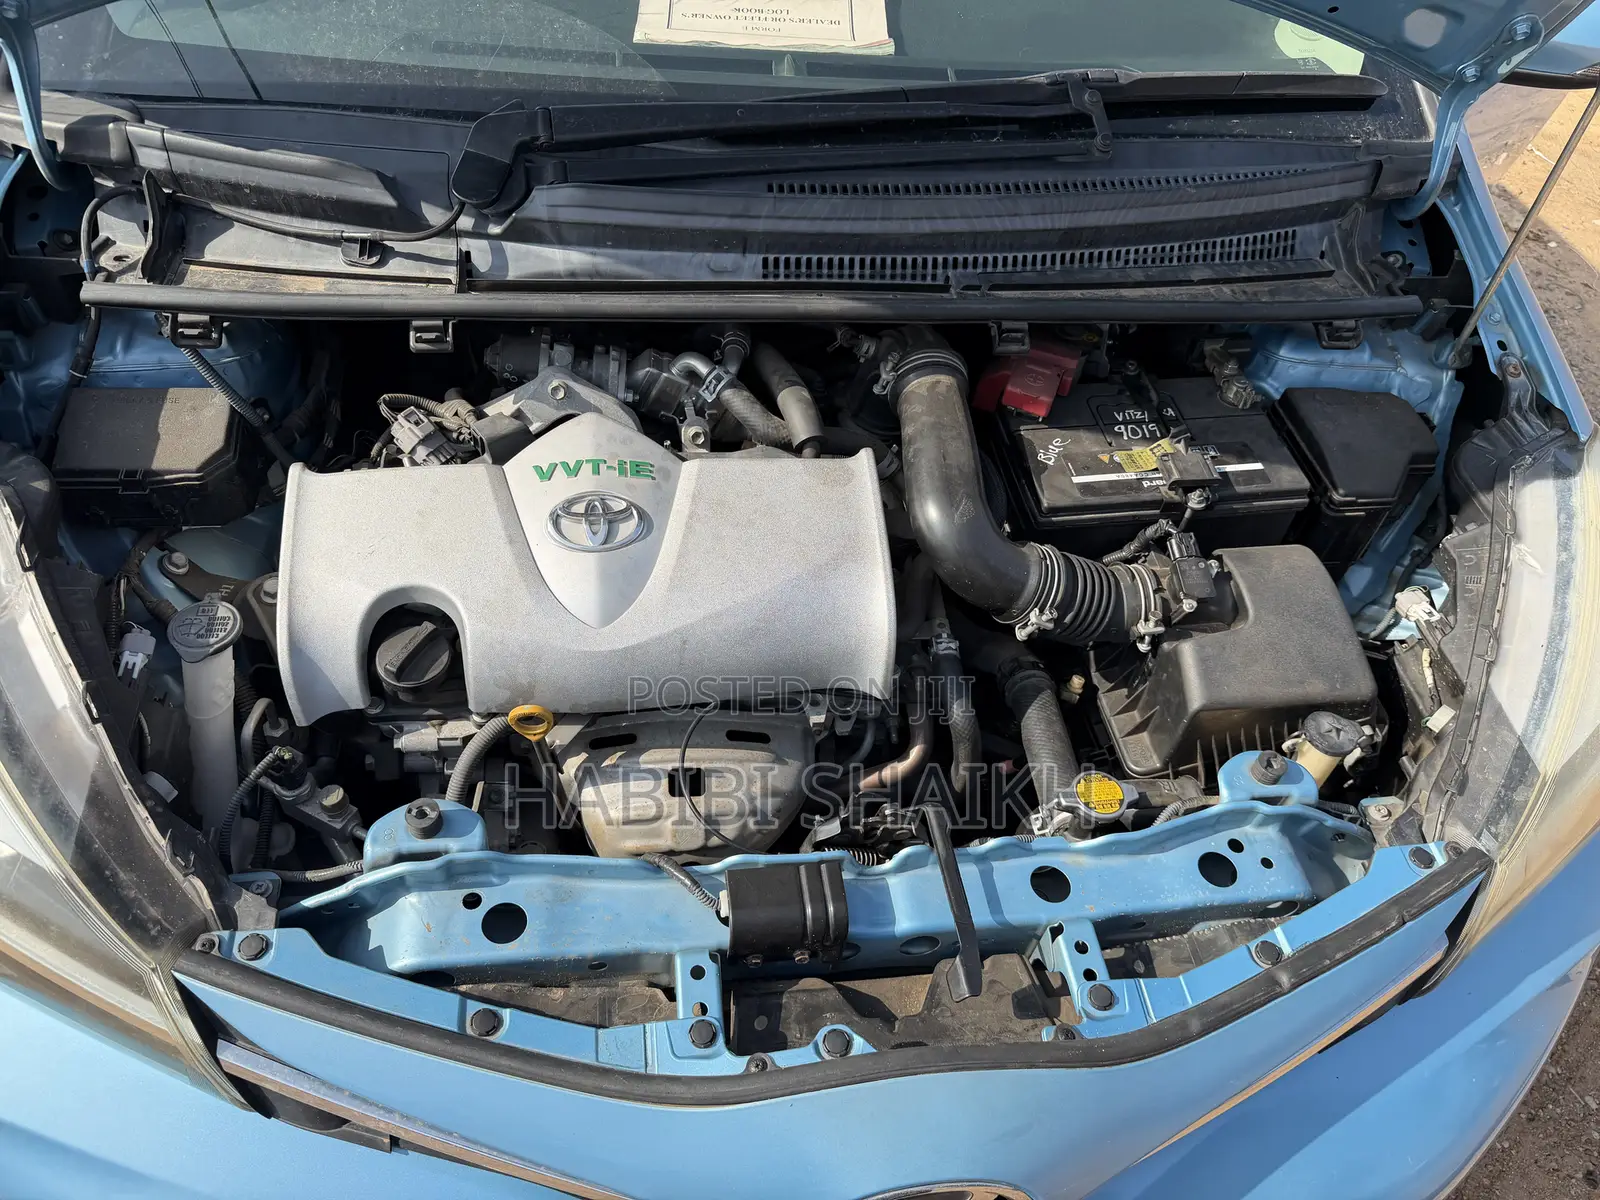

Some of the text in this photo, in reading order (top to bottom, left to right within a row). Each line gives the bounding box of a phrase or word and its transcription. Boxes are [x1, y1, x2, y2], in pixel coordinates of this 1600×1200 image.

[681, 13, 732, 21] OWNER'S
[788, 17, 841, 26] DEALER'S
[1037, 438, 1071, 466] Blue
[532, 458, 656, 482] VVT-iE
